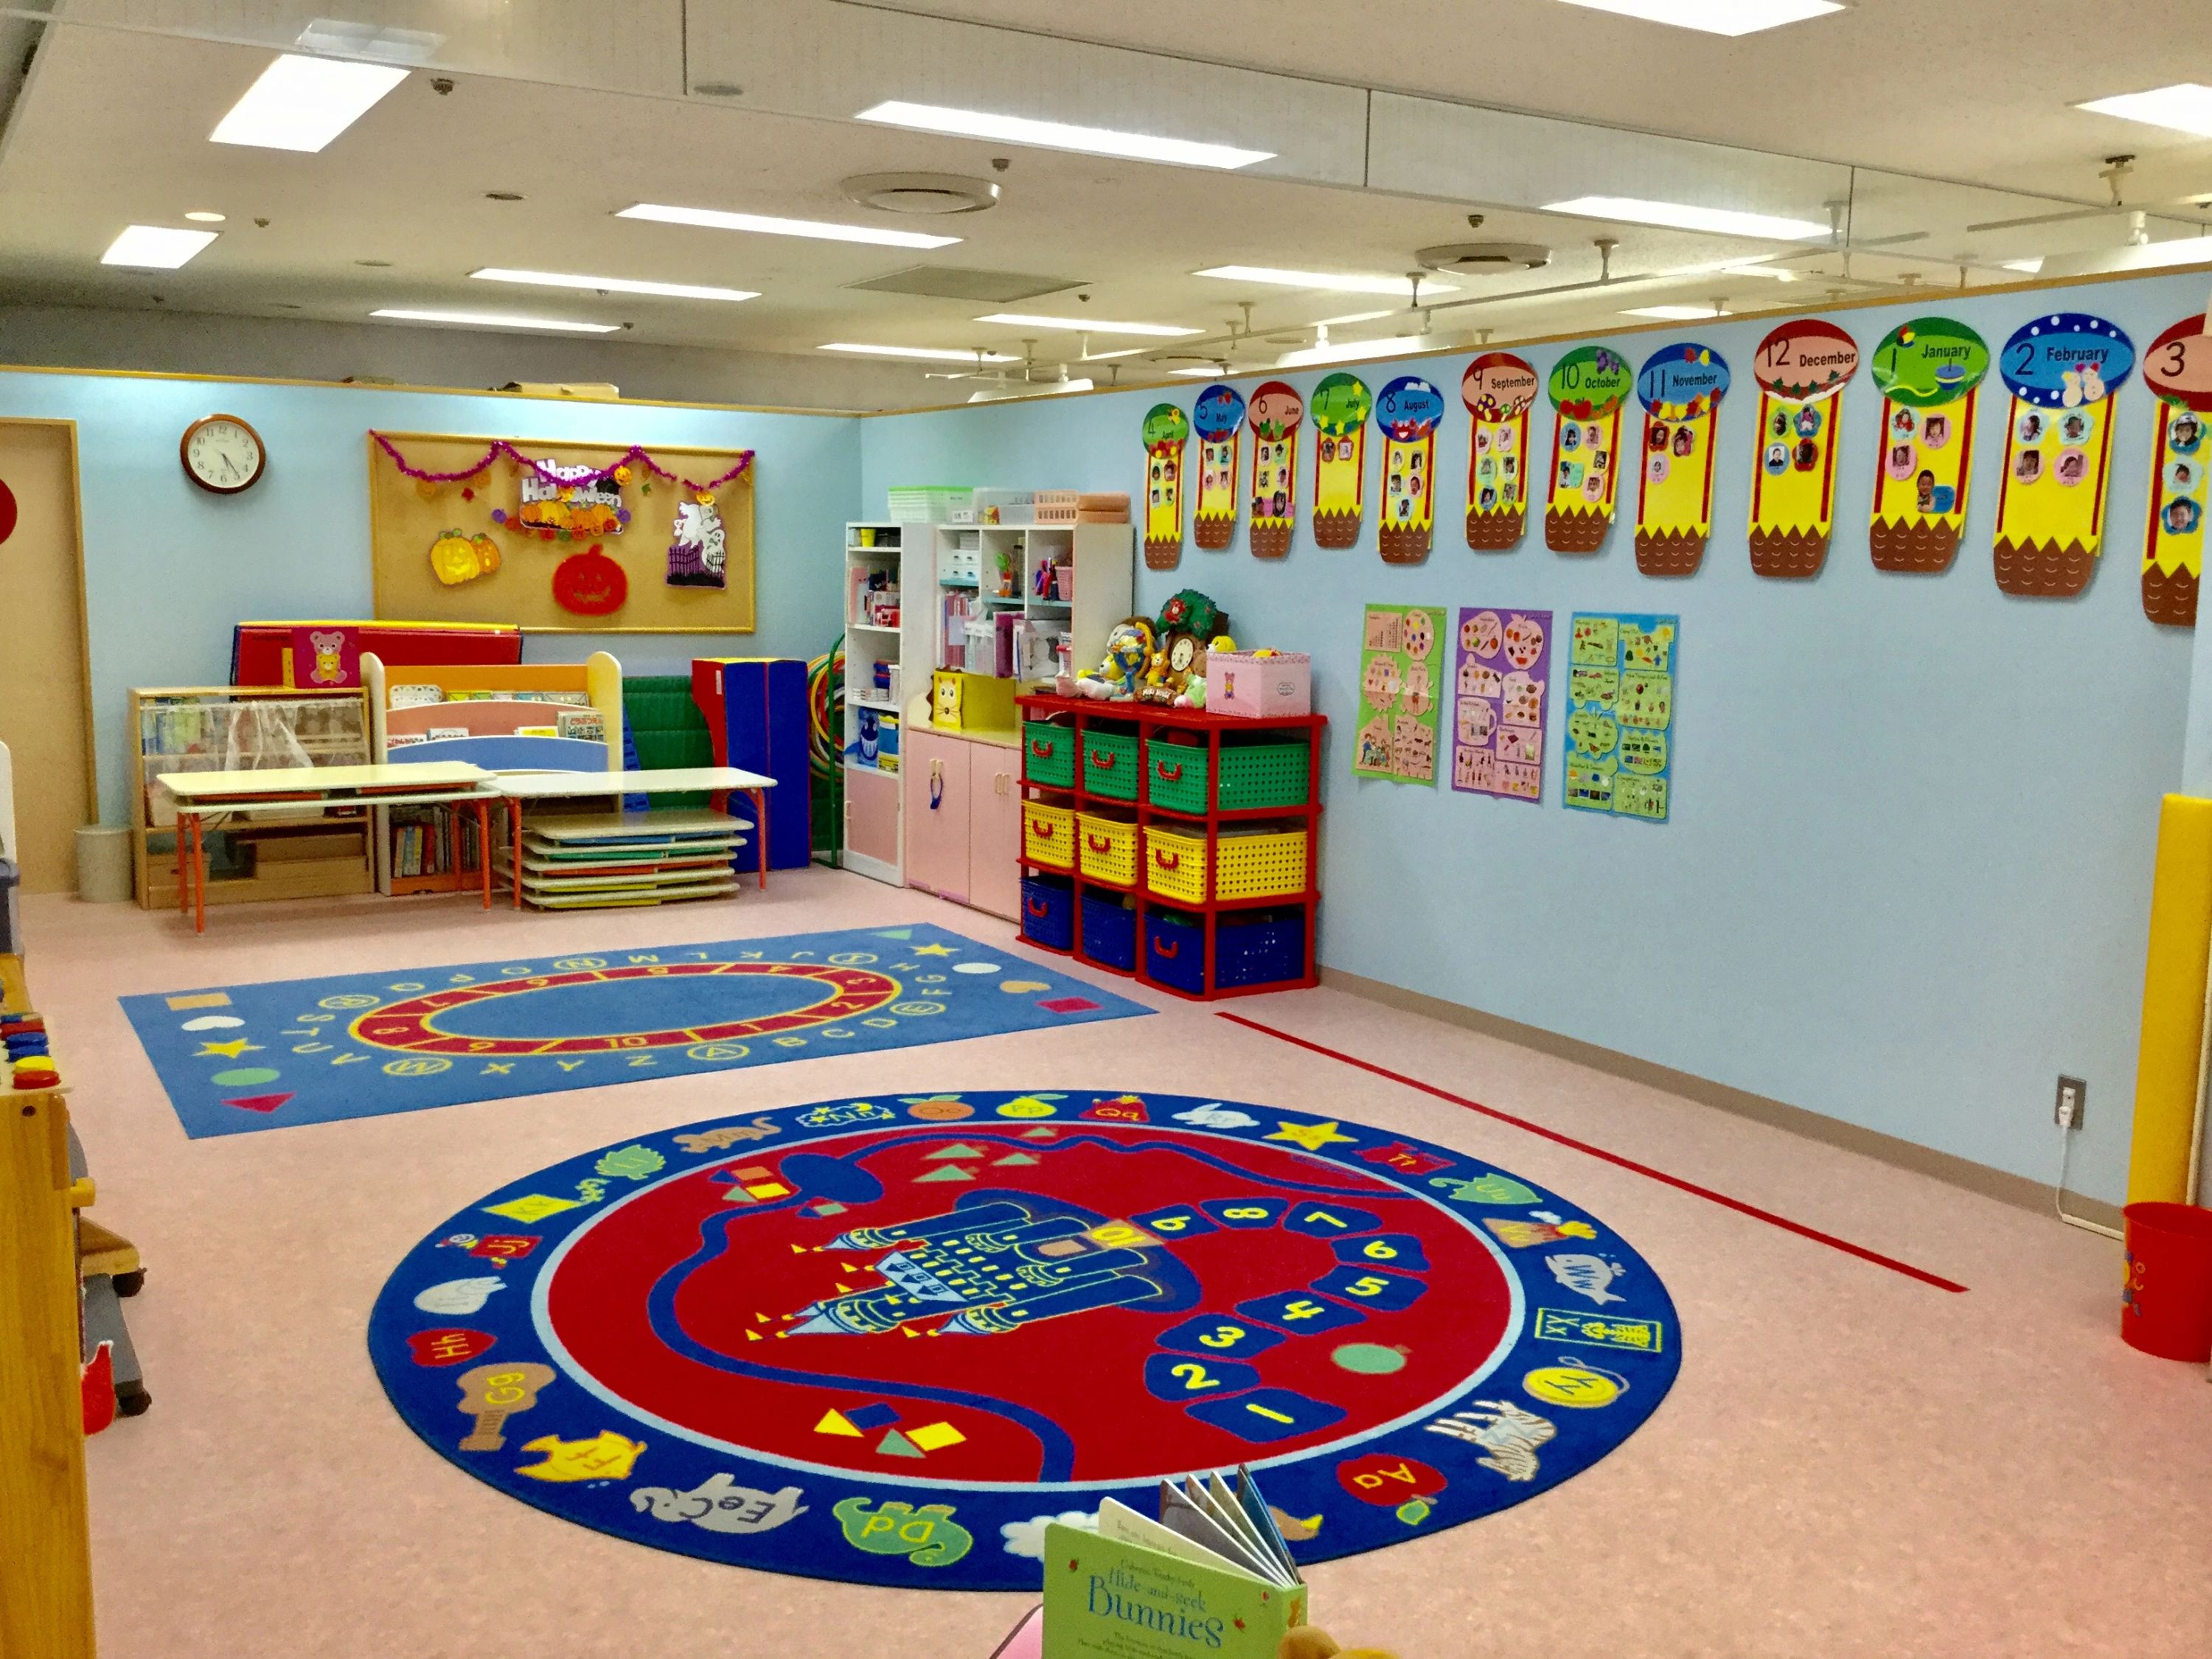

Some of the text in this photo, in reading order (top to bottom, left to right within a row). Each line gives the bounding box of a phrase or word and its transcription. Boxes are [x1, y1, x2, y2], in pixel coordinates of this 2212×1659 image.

[1767, 339, 1856, 368] 12 December
[1921, 345, 1971, 360] January
[2014, 342, 2109, 375] 2 February
[2160, 341, 2185, 377] 3
[1473, 365, 1535, 391] 9 September
[1561, 364, 1621, 389] 10 October
[1650, 370, 1717, 397] 11 November
[1259, 395, 1299, 415] 6 June
[1346, 398, 1360, 411] July
[1385, 389, 1429, 413] 8 August
[1200, 405, 1227, 422] 5 May
[1148, 419, 1155, 437] 4
[827, 1110, 876, 1122] Nn
[919, 1107, 962, 1115] Oo
[1011, 1104, 1044, 1113] Pp
[1095, 1107, 1139, 1121] Qq
[1205, 1113, 1236, 1125] Rr
[1292, 1127, 1322, 1142] Ss
[1388, 1152, 1417, 1167] Tt
[1476, 1183, 1511, 1200] Uu
[1150, 1215, 1191, 1231] 9
[1222, 1207, 1268, 1220] 8
[1304, 1211, 1348, 1228] 7
[1091, 1225, 1147, 1246] 10
[487, 1239, 530, 1254] Jj
[1363, 1240, 1398, 1259] 6
[1345, 1276, 1390, 1296] 5
[1562, 1265, 1601, 1290] Ww
[1281, 1300, 1325, 1321] 4
[1545, 1315, 1580, 1336] Xx
[431, 1333, 472, 1359] Hh
[1199, 1326, 1246, 1348] 3
[1171, 1363, 1220, 1390] 2
[1544, 1374, 1599, 1396] Yy
[484, 1371, 526, 1405] Gg
[1245, 1403, 1295, 1424] 1
[566, 1446, 622, 1471] Ff
[1353, 1462, 1416, 1489] Aa
[860, 1516, 936, 1544] Dd
[1088, 1575, 1224, 1648] Bunnies
